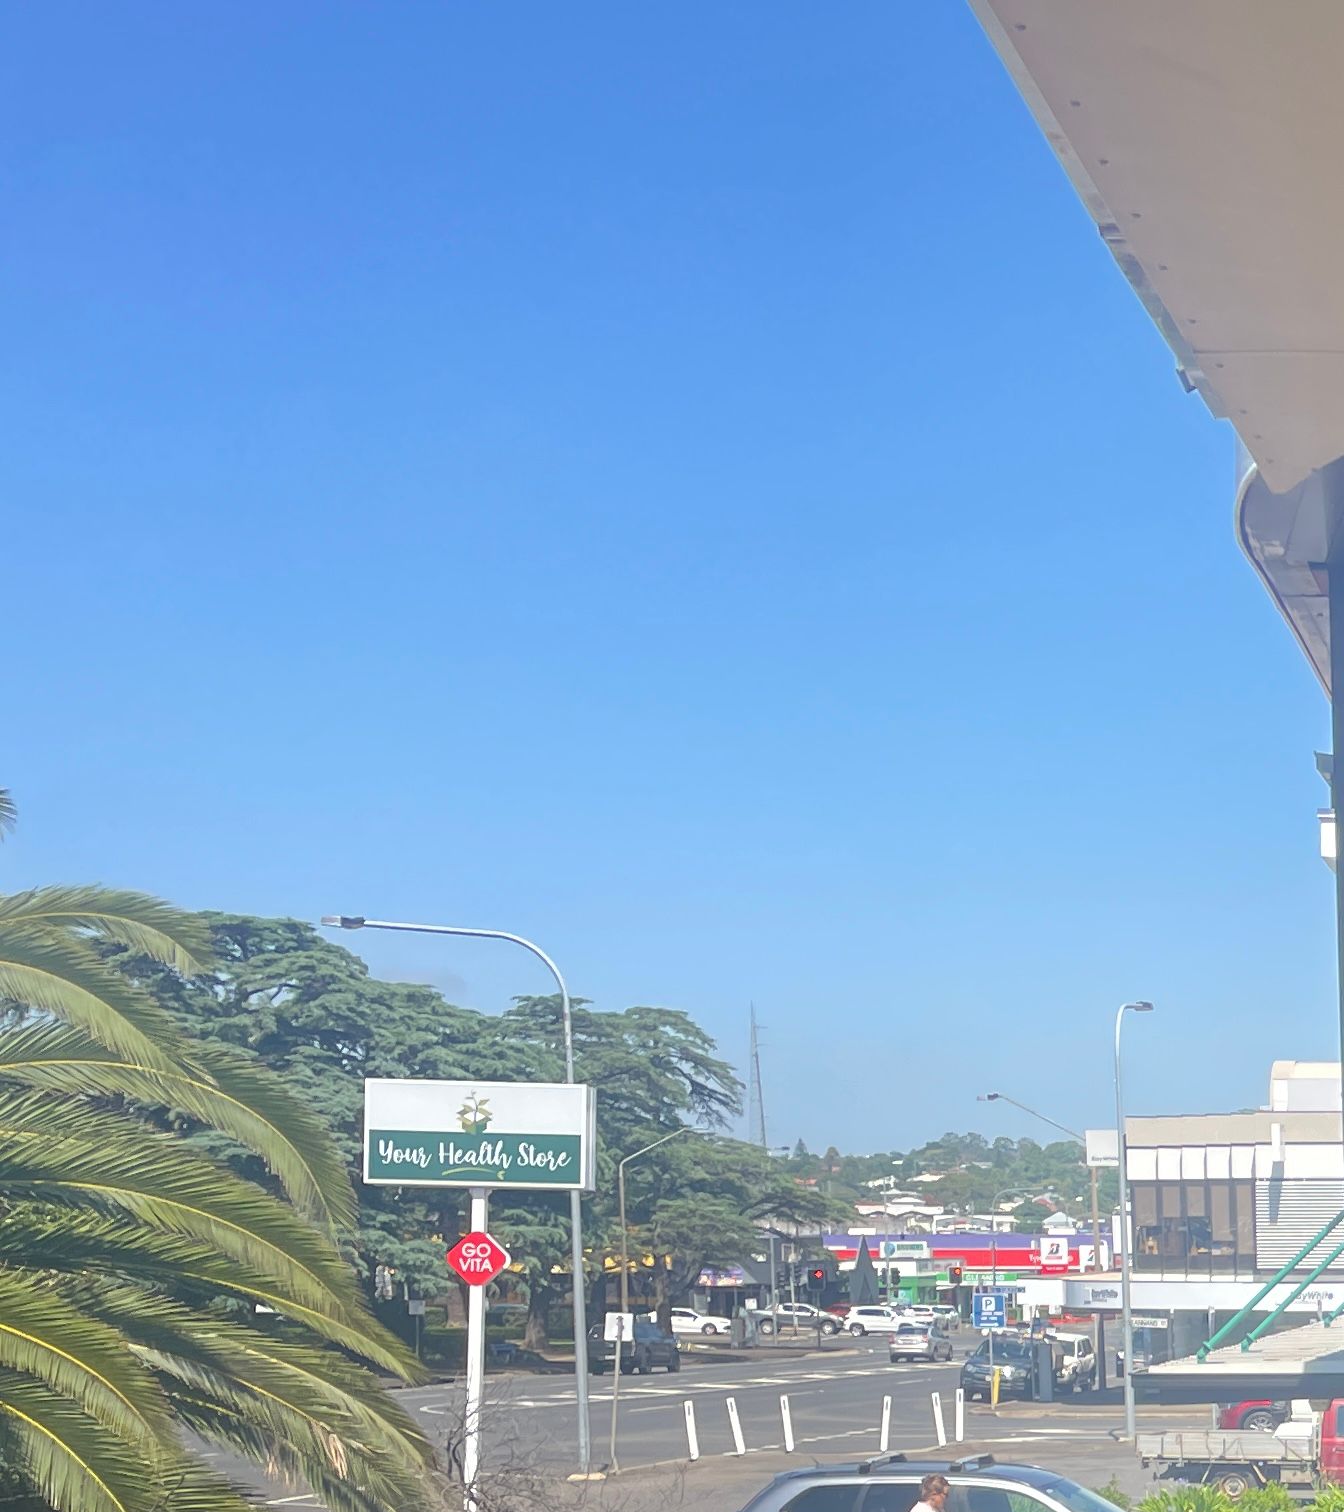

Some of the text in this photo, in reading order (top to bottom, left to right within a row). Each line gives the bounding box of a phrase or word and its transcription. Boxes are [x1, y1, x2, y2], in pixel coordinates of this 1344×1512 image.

[378, 1139, 572, 1171] Your Health Store
[461, 1242, 491, 1258] GO
[458, 1258, 493, 1273] VITA
